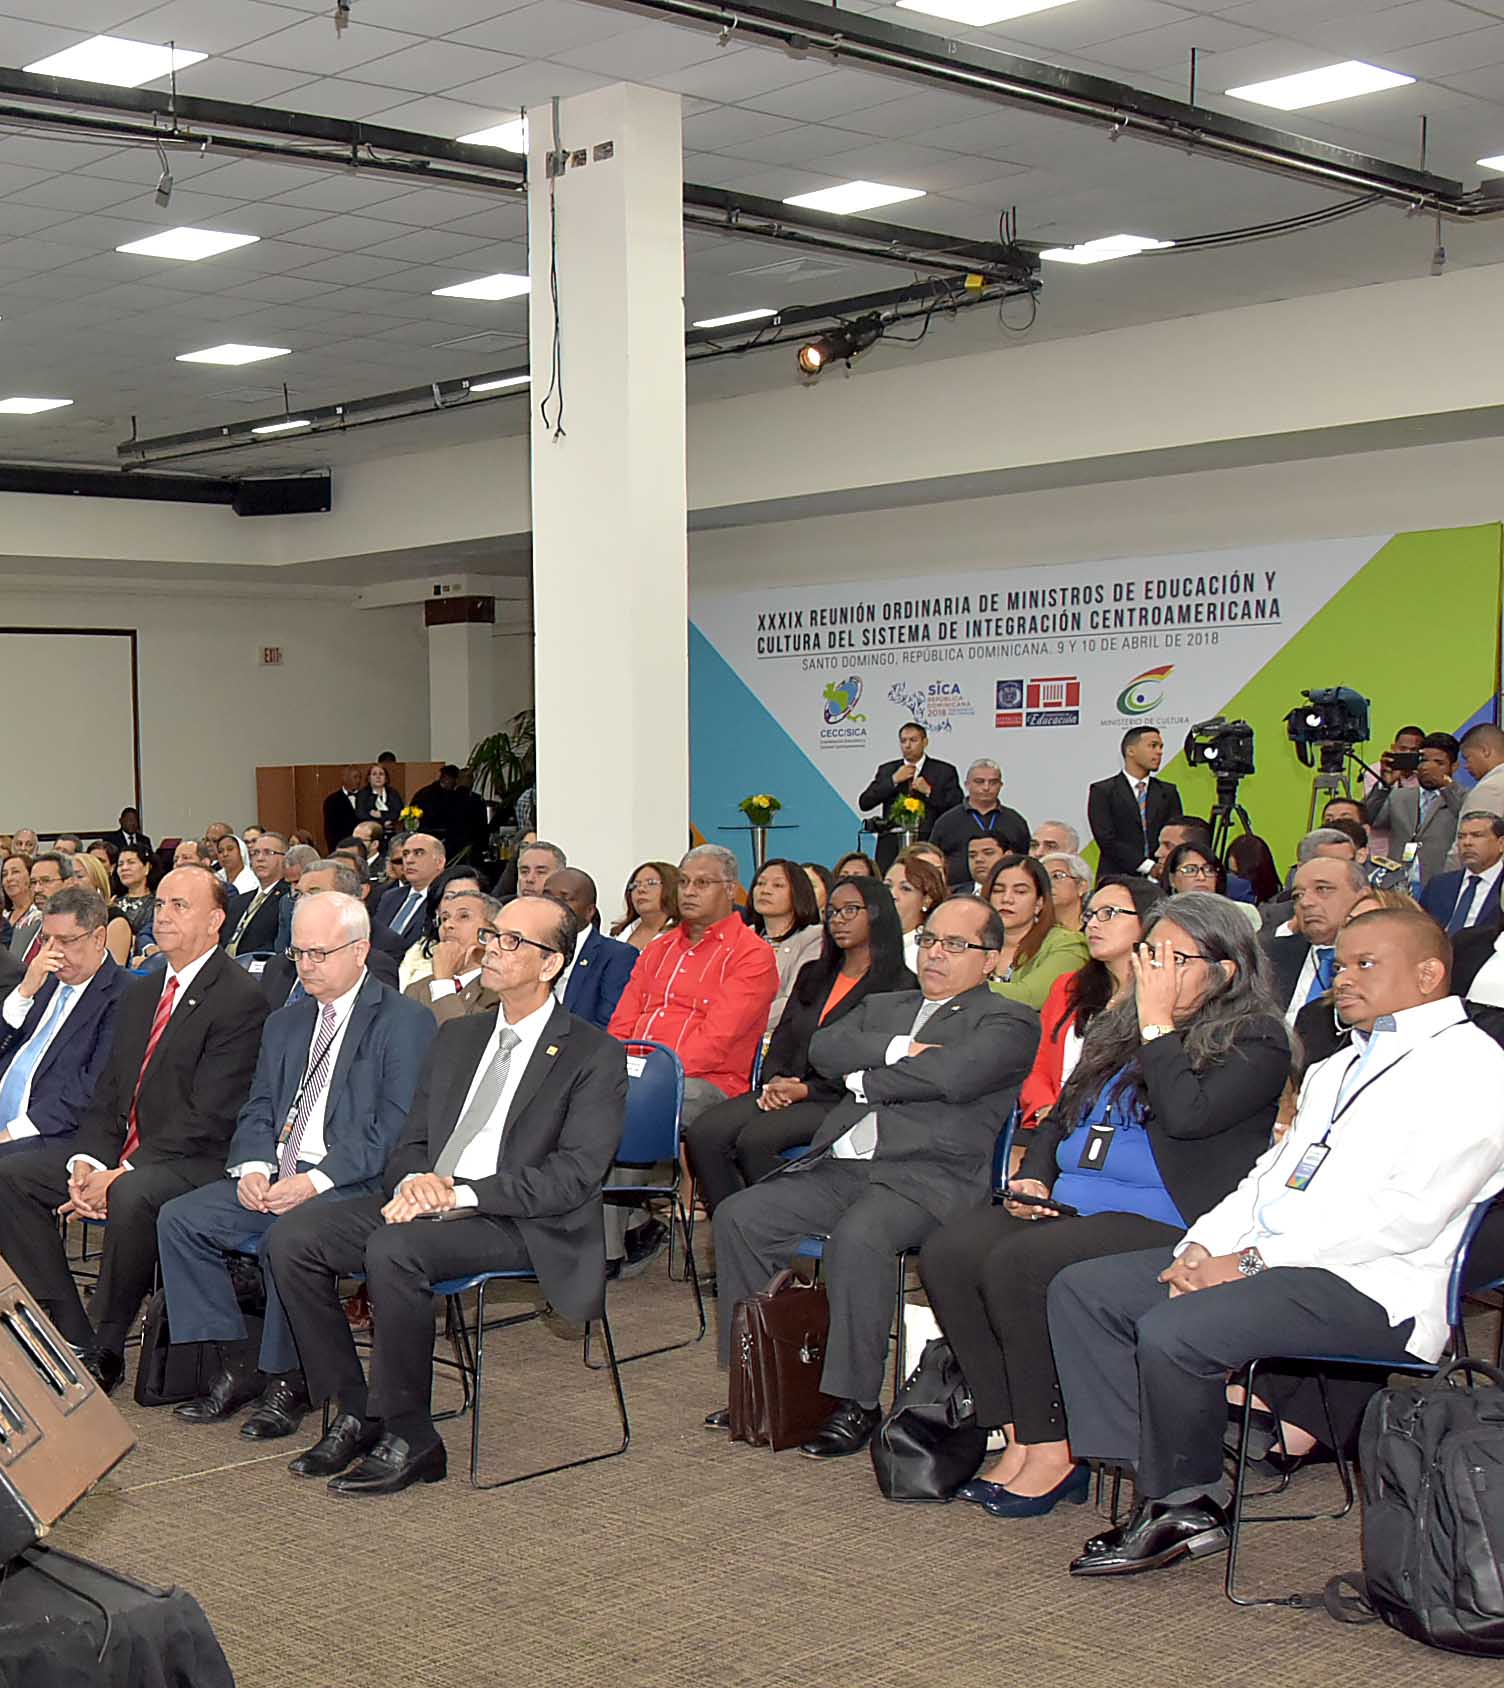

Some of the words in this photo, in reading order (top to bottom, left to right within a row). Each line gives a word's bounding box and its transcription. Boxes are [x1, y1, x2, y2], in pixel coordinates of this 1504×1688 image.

[758, 611, 803, 631] XXXIX
[810, 602, 876, 627] REUNIÓN
[883, 596, 971, 620] ORDINARIA
[979, 593, 999, 613] DE
[1007, 585, 1104, 611] MINISTROS
[1113, 582, 1135, 602] DE
[1145, 570, 1255, 600] EDUCACIÓN
[1265, 571, 1276, 592] Y
[757, 633, 821, 654] CULTURA
[828, 630, 855, 648] DEL
[862, 623, 930, 646] SISTEMA
[938, 621, 958, 640] DE
[966, 610, 1081, 638] INTEGRACIÓN
[1090, 598, 1280, 629] CENTROAMERICANA
[802, 658, 838, 671] SANTO
[842, 652, 898, 668] DOMINGO,
[902, 645, 964, 664] REPÚBLICA
[1058, 641, 1064, 653] 9
[1069, 640, 1077, 652] Y
[1082, 639, 1096, 651] 10
[1101, 637, 1117, 650] DE
[1122, 634, 1160, 650] ABRIL
[1165, 633, 1182, 647] DE
[1187, 631, 1219, 646] 2018
[928, 680, 961, 695] SICA
